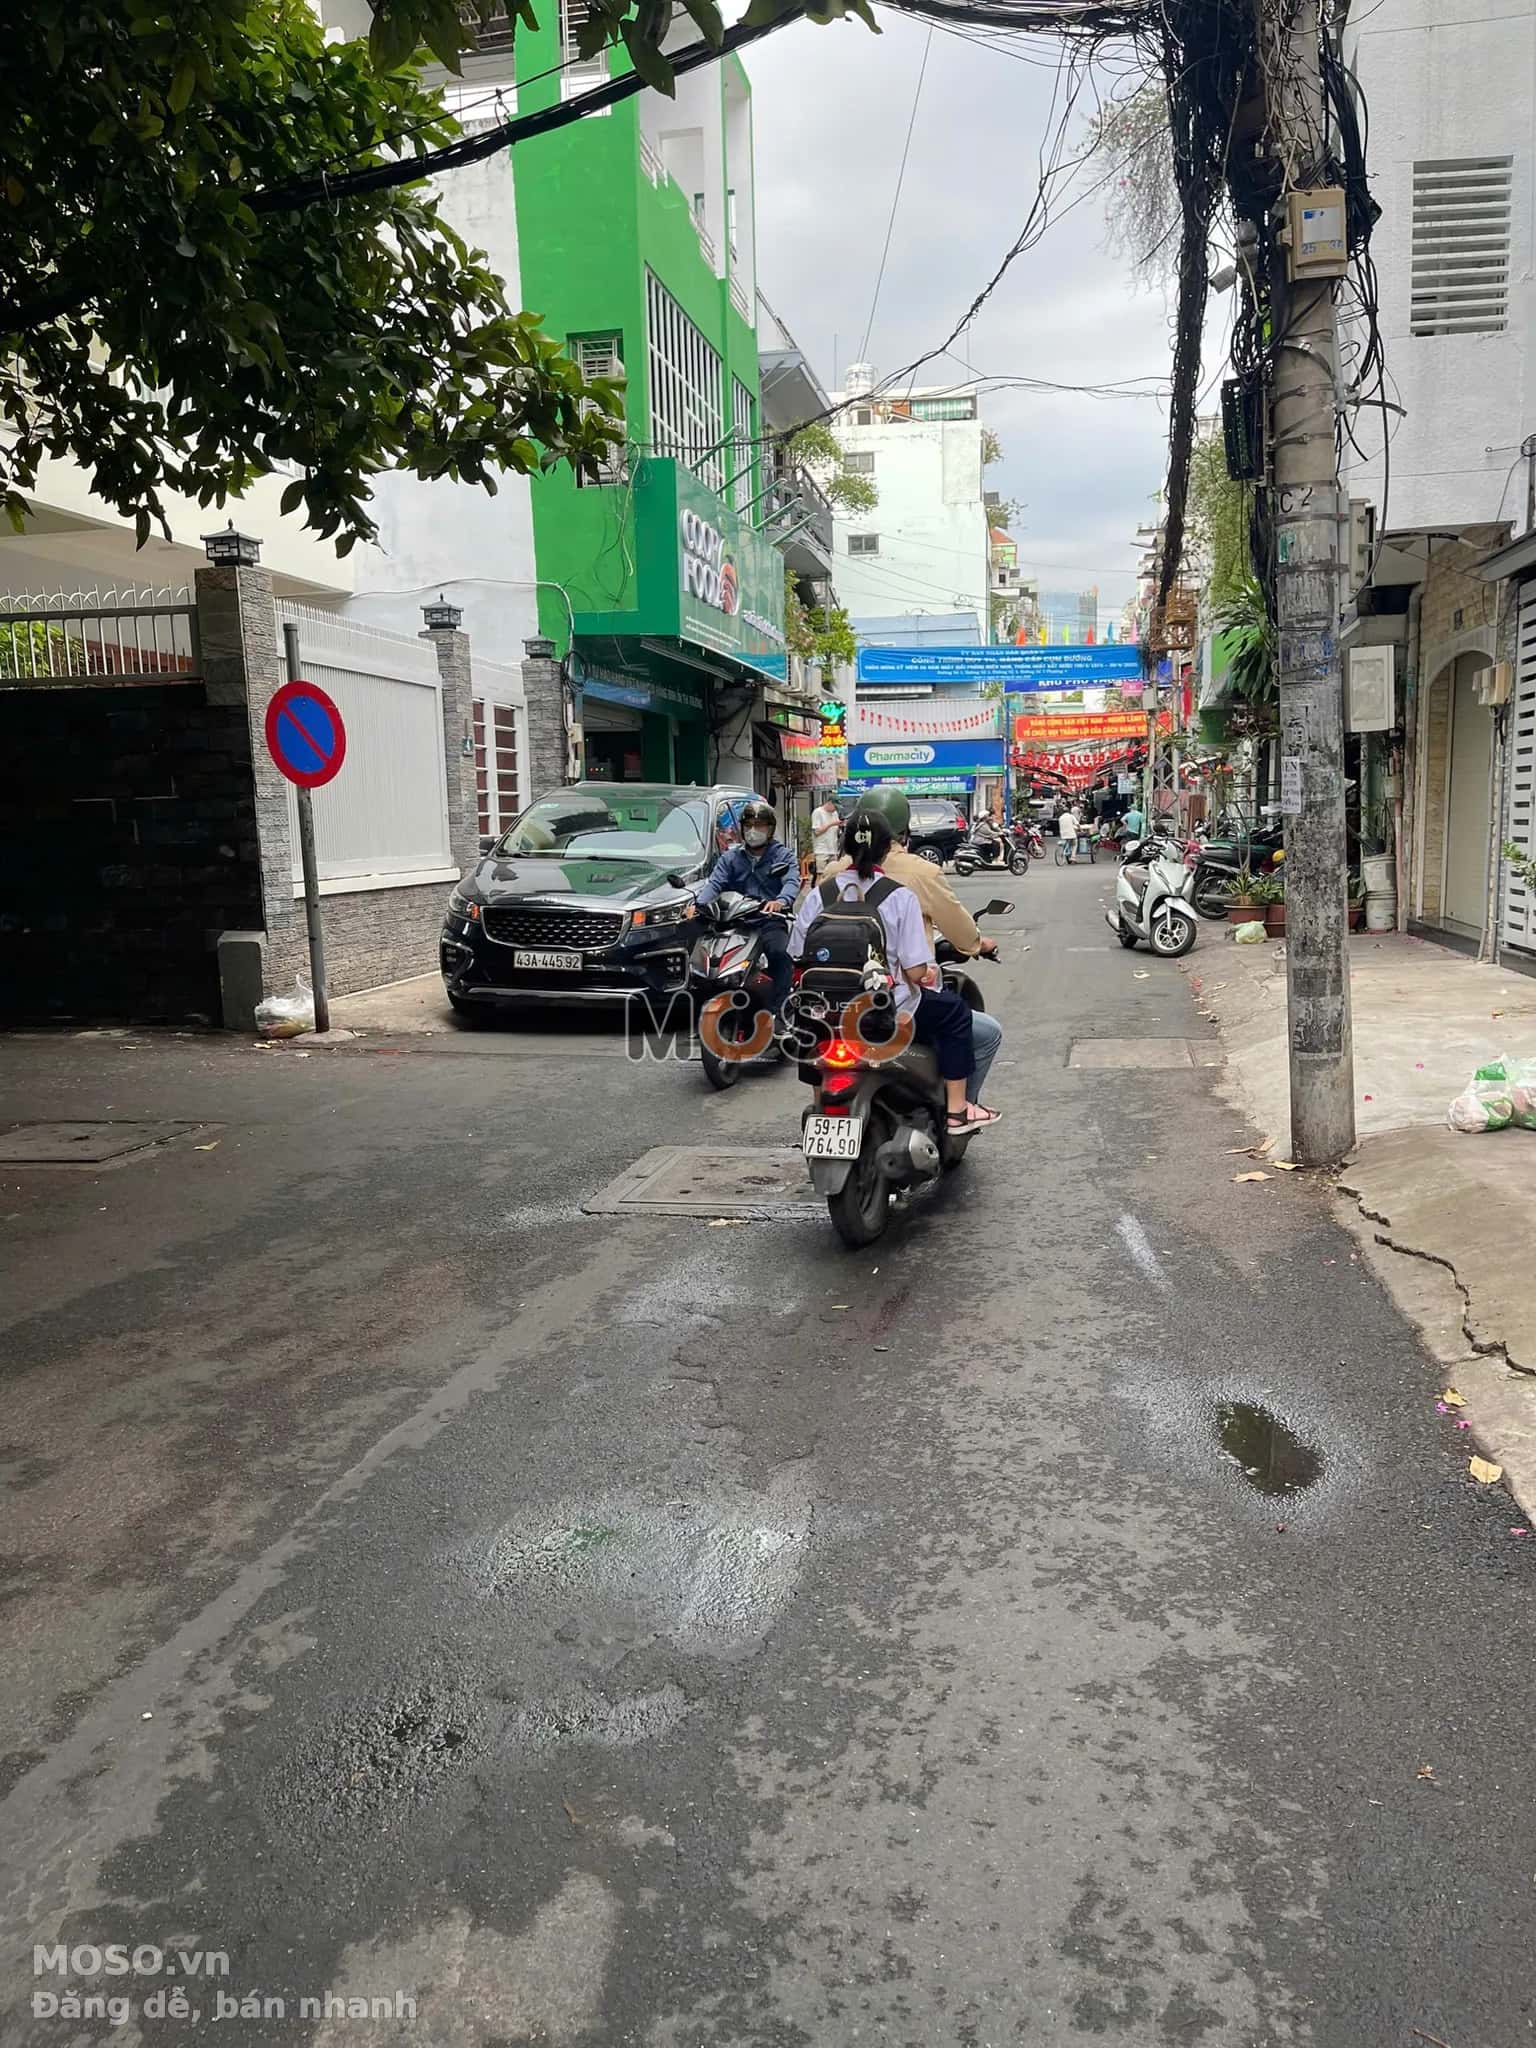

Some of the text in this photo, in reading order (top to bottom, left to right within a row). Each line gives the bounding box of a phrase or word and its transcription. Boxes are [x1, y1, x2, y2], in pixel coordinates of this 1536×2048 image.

[911, 655, 936, 664] CÔNG
[869, 750, 930, 761] Pharmacity
[516, 953, 580, 969] 43A-445.92
[814, 1118, 851, 1136] 59-F1
[808, 1137, 856, 1155] 764.90
